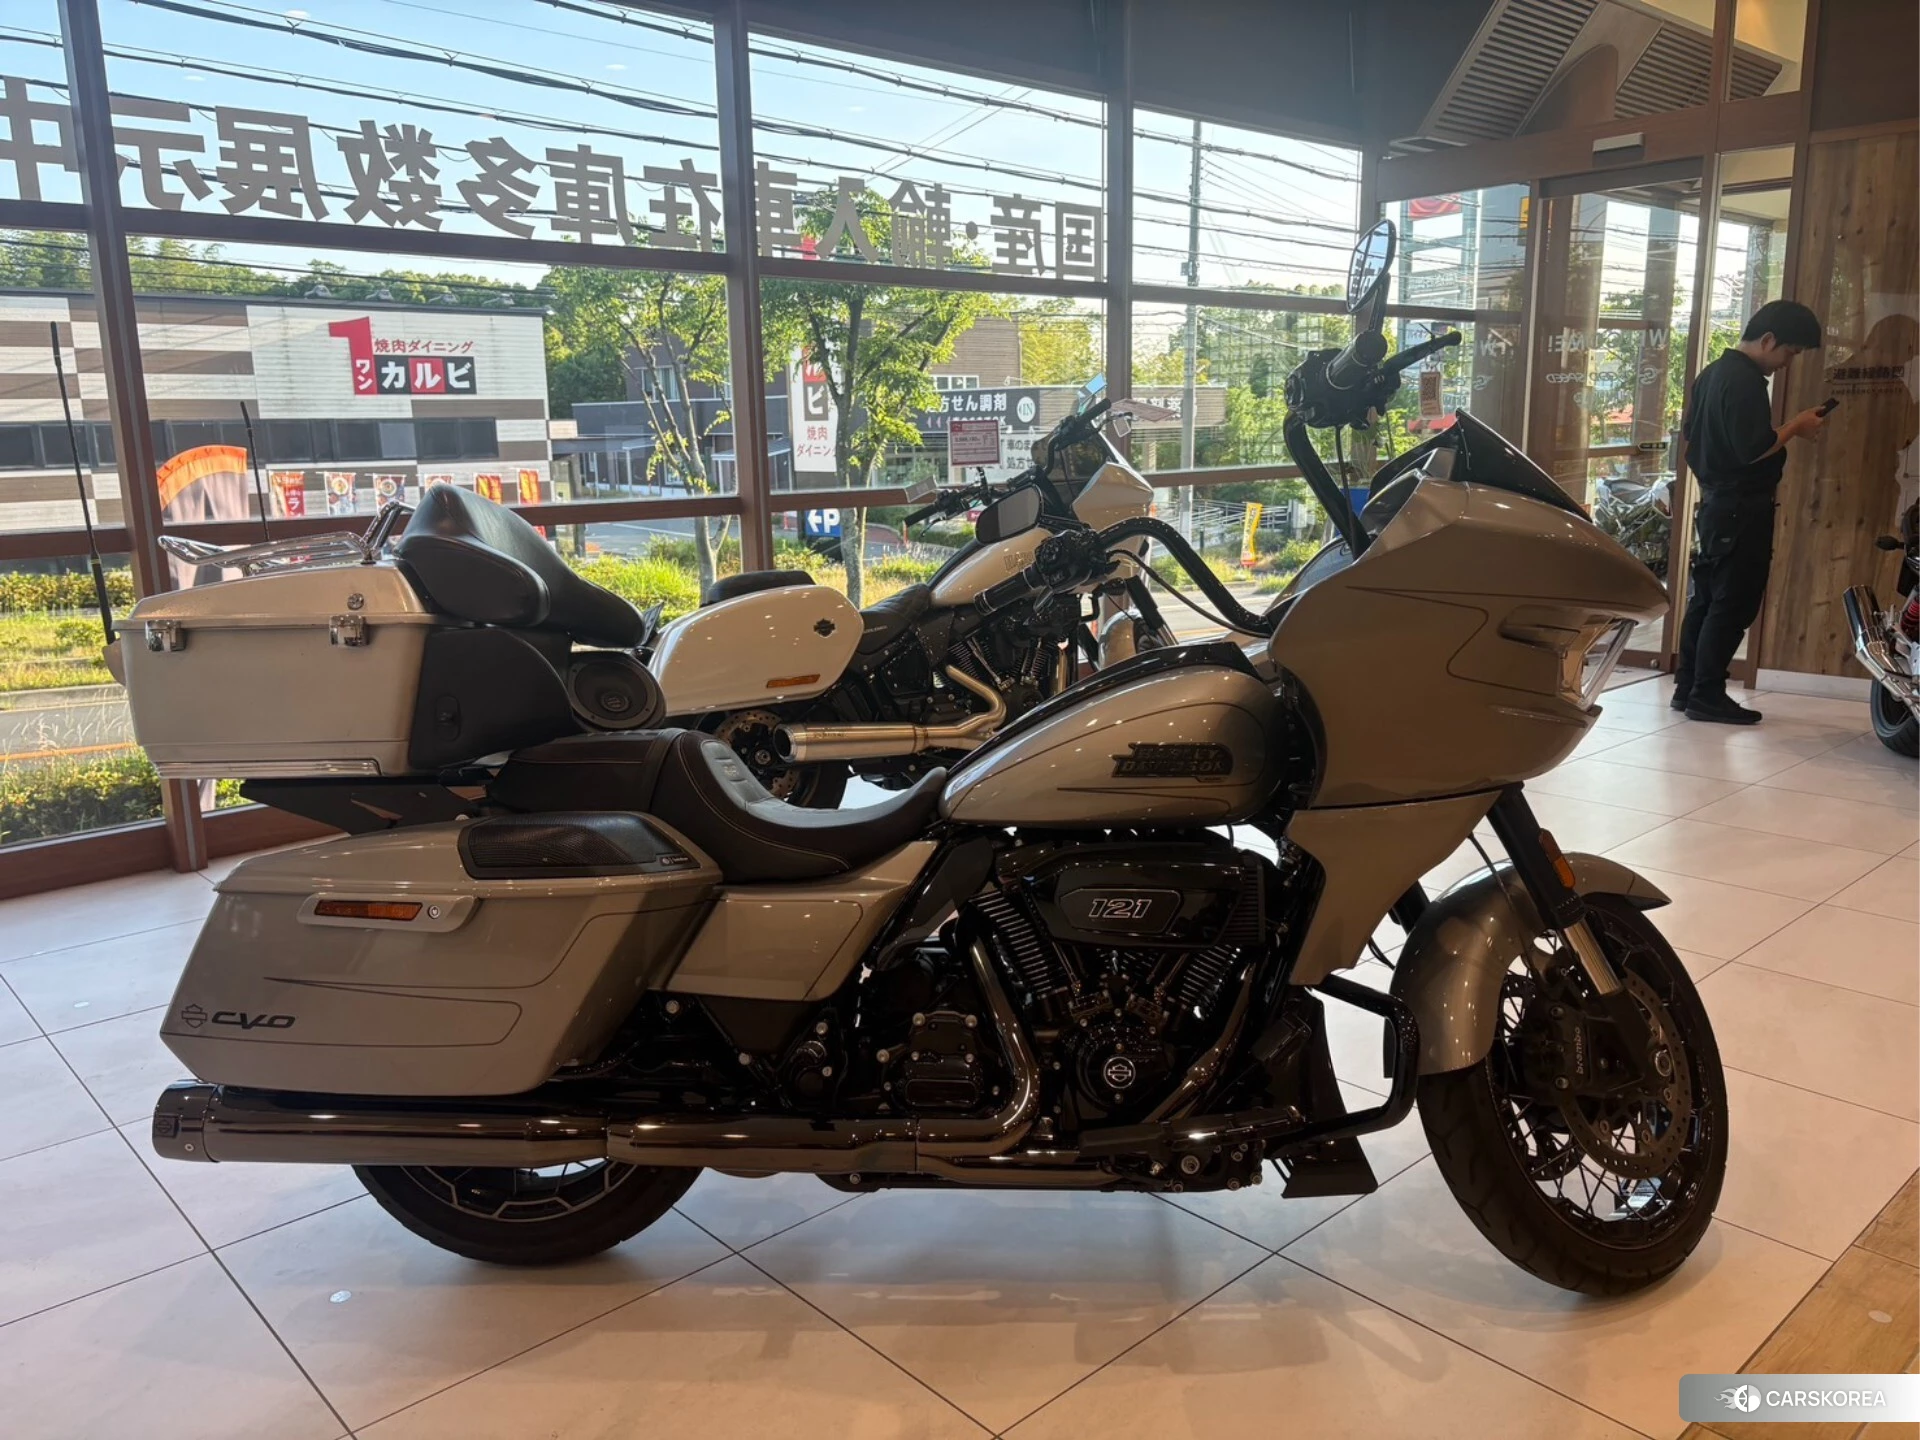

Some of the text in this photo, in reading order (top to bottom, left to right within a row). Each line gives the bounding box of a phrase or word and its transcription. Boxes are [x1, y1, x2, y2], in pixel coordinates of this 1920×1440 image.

[374, 338, 474, 354] 焼肉ダイニング
[355, 359, 373, 391] ワン
[381, 360, 472, 389] カルビ
[807, 426, 828, 440] 焼肉
[823, 508, 840, 533] P
[1088, 898, 1152, 918] 121
[211, 1011, 295, 1029] CVO
[1573, 1026, 1585, 1075] brembo
